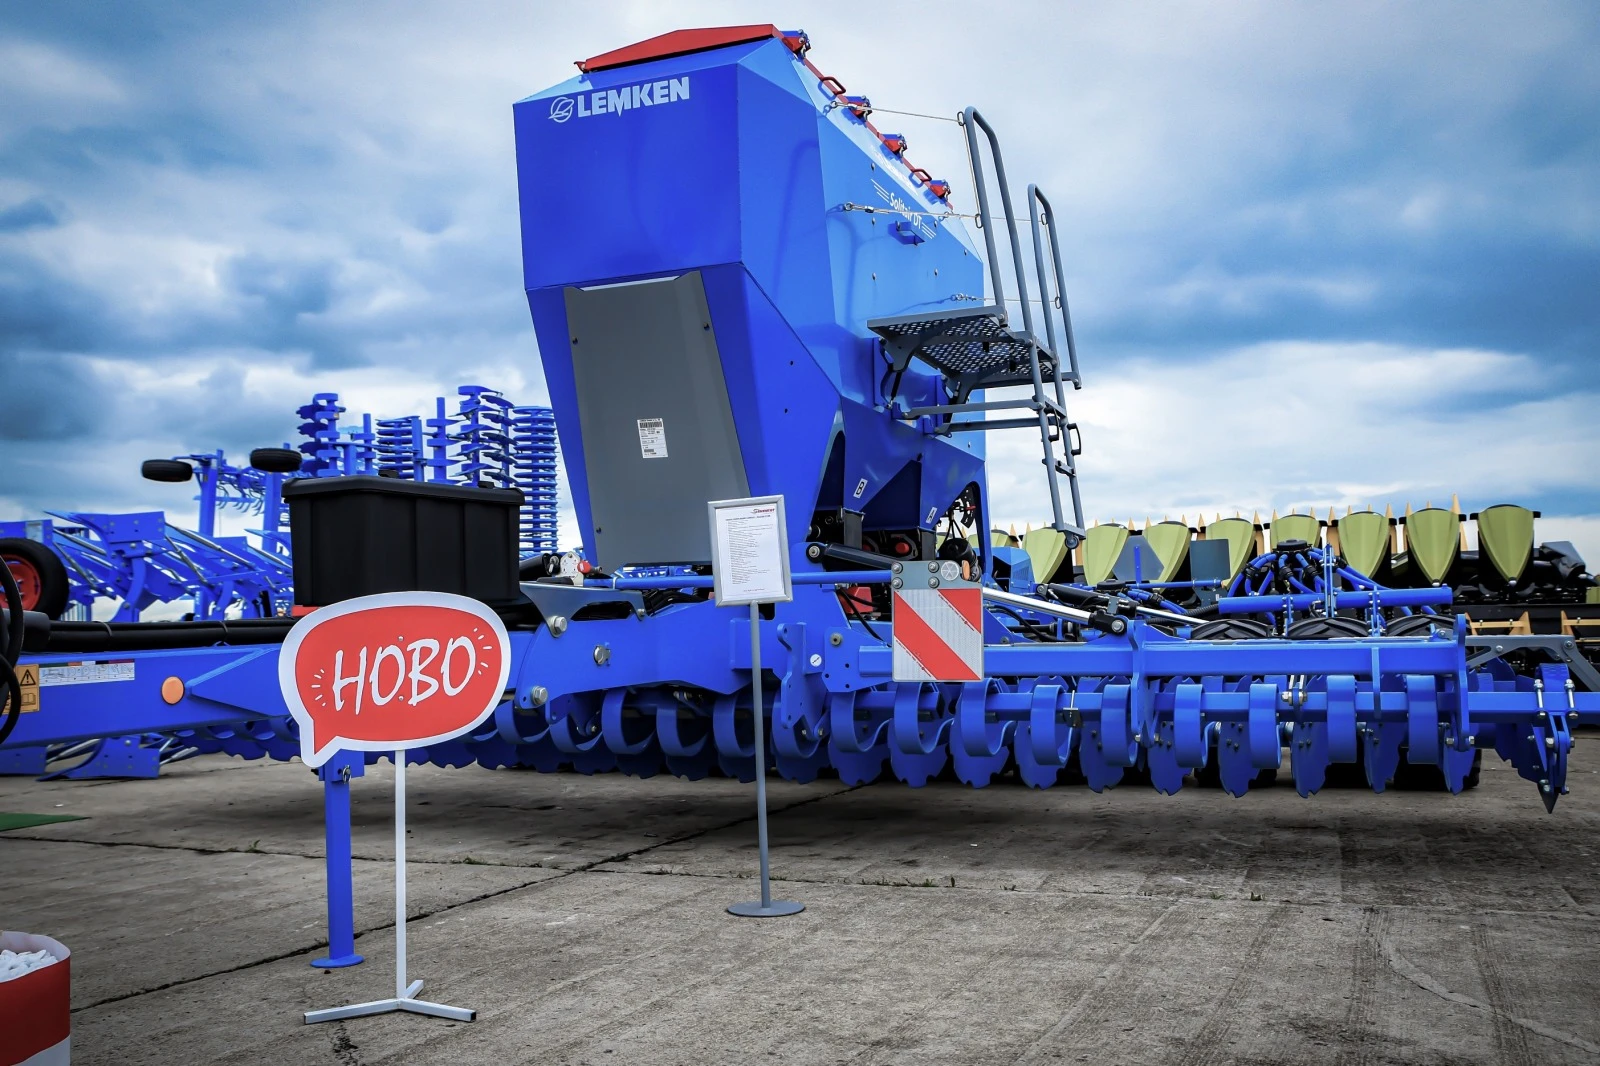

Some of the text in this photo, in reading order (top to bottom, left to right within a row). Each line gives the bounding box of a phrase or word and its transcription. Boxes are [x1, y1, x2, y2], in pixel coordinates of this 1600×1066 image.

[577, 76, 690, 117] LEMKEN
[889, 192, 922, 230] Solitair DT
